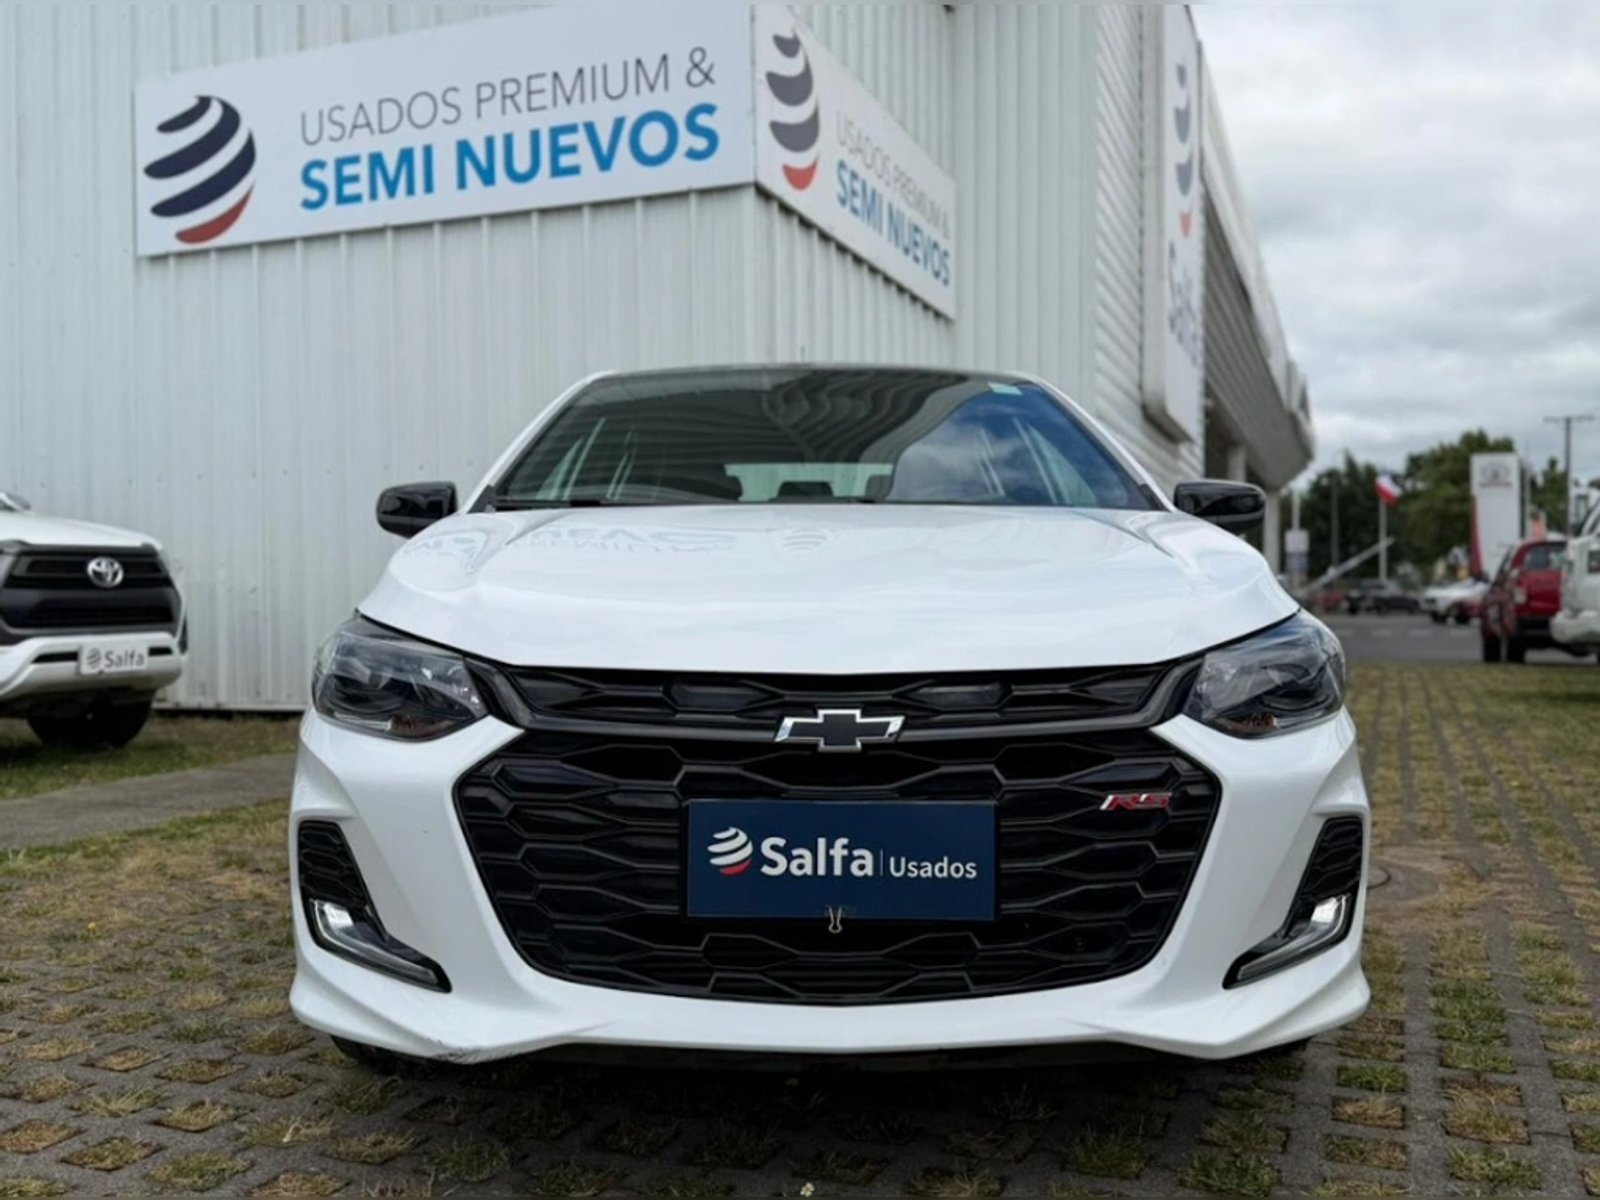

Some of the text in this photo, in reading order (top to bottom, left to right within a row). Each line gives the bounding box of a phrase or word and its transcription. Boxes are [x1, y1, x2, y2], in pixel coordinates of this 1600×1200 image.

[300, 47, 717, 146] USADOS PREMIUM &
[300, 103, 719, 210] SEMI NUEVOS
[837, 159, 950, 287] SEMI NUEVOS
[105, 650, 145, 669] Salfa
[1100, 793, 1171, 810] RS
[760, 836, 978, 879] Salfa Usados
